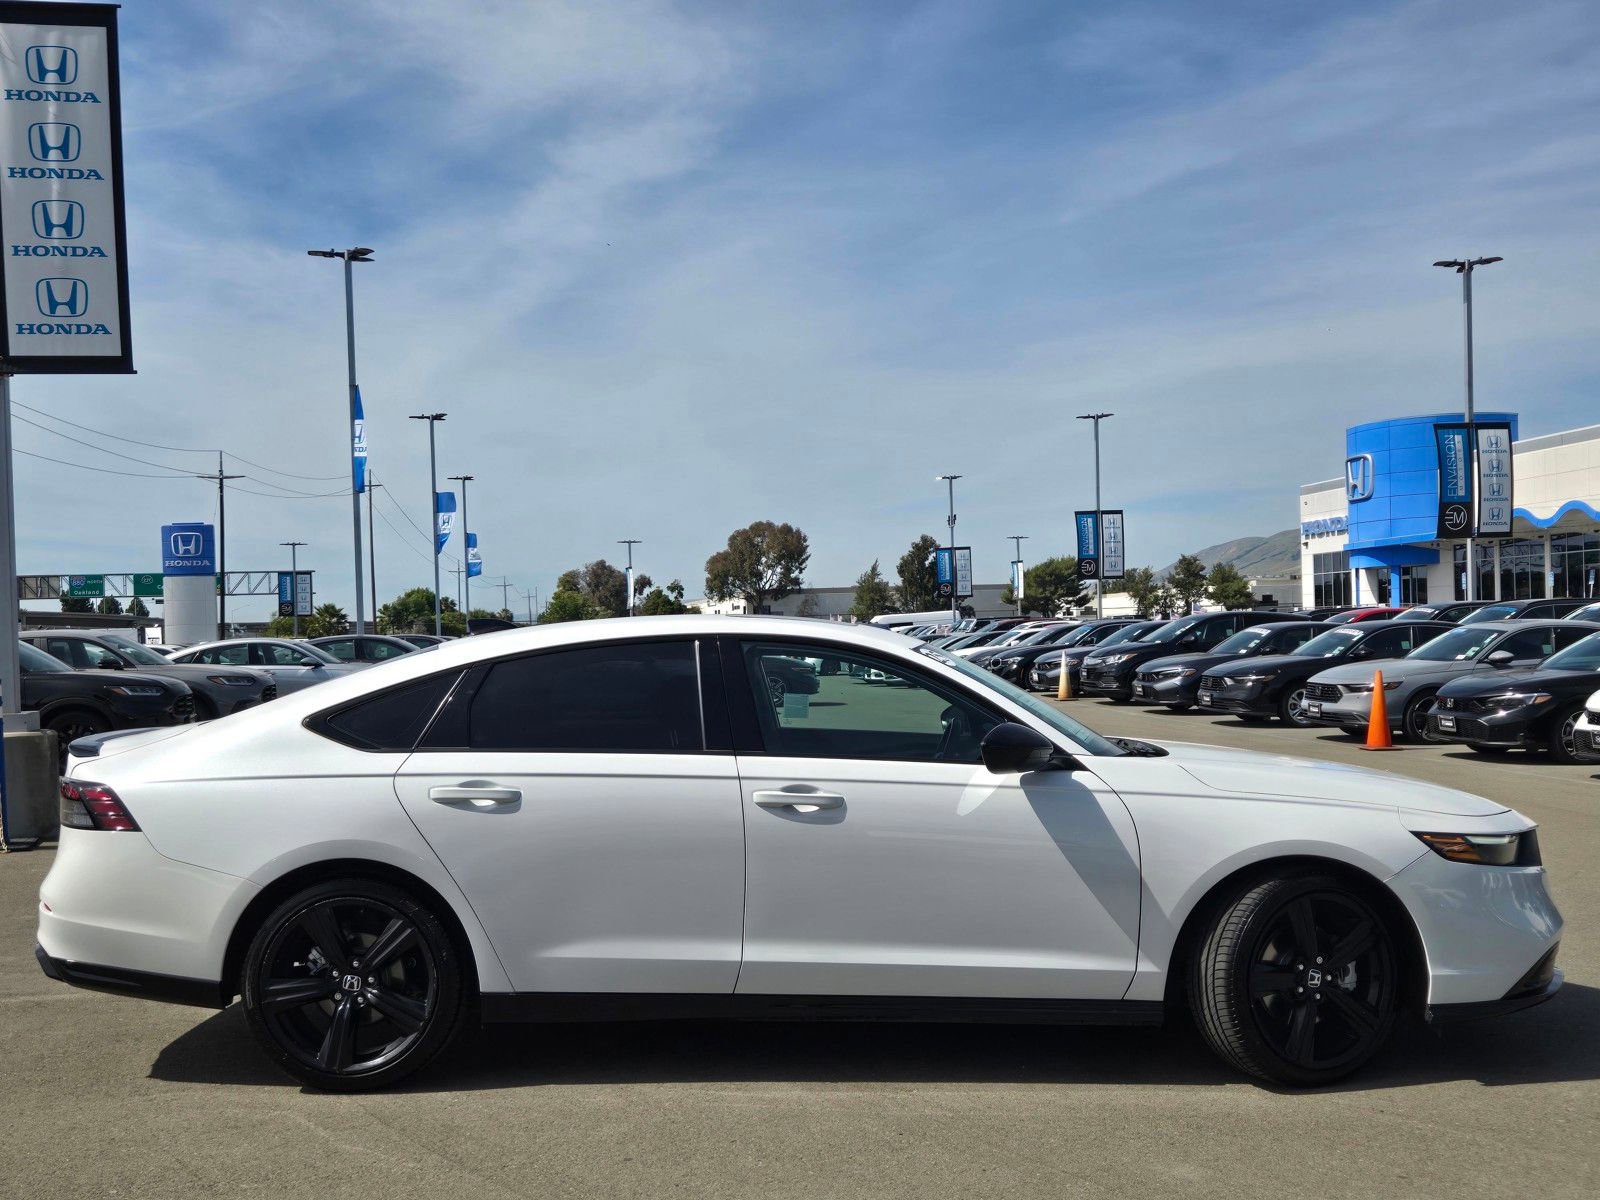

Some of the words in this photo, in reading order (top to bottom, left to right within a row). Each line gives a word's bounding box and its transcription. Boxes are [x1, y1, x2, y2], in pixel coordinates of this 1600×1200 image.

[5, 89, 101, 103] HONDA
[8, 168, 104, 181] HONDA
[11, 244, 108, 257] HONDA
[16, 323, 112, 335] HONDA
[1444, 434, 1458, 497] ENVISION
[165, 559, 209, 567] HONDA
